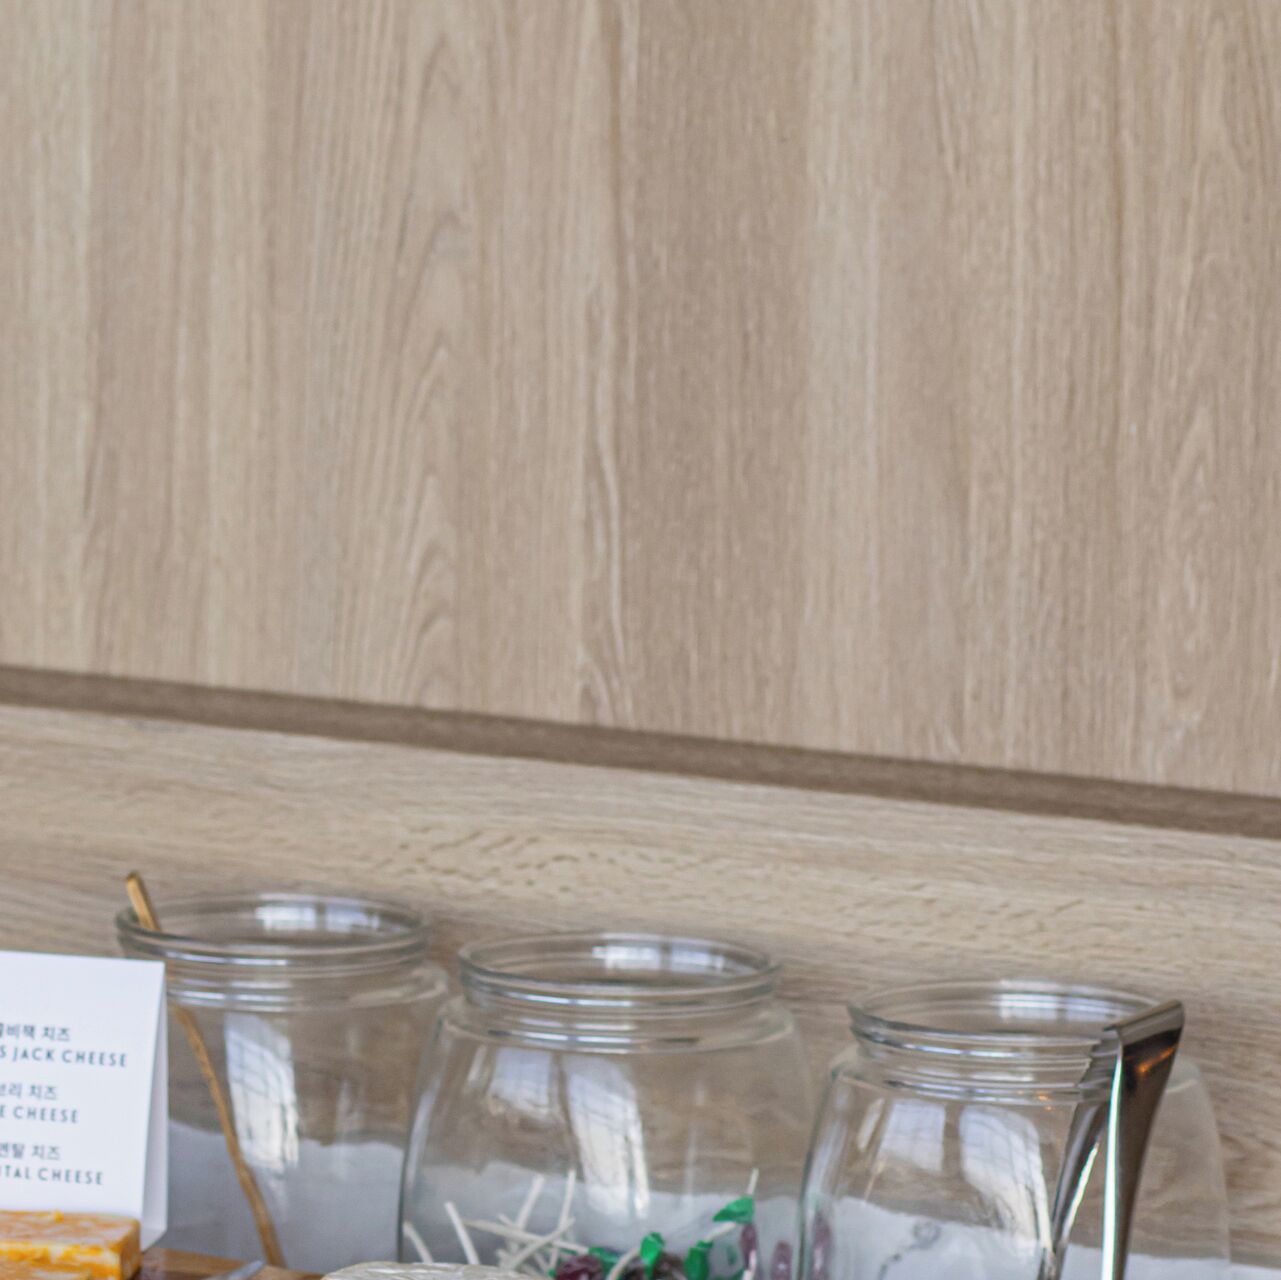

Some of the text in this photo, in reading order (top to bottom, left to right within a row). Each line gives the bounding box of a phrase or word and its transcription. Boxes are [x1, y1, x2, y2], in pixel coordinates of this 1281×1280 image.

[41, 1025, 71, 1042] 치즈
[12, 1046, 55, 1062] JACK
[62, 1050, 128, 1068] CHEESE
[28, 1084, 58, 1100] 치즈
[13, 1106, 79, 1124] CHEESE
[31, 1144, 61, 1161] 치즈
[37, 1168, 103, 1185] CHEESE
